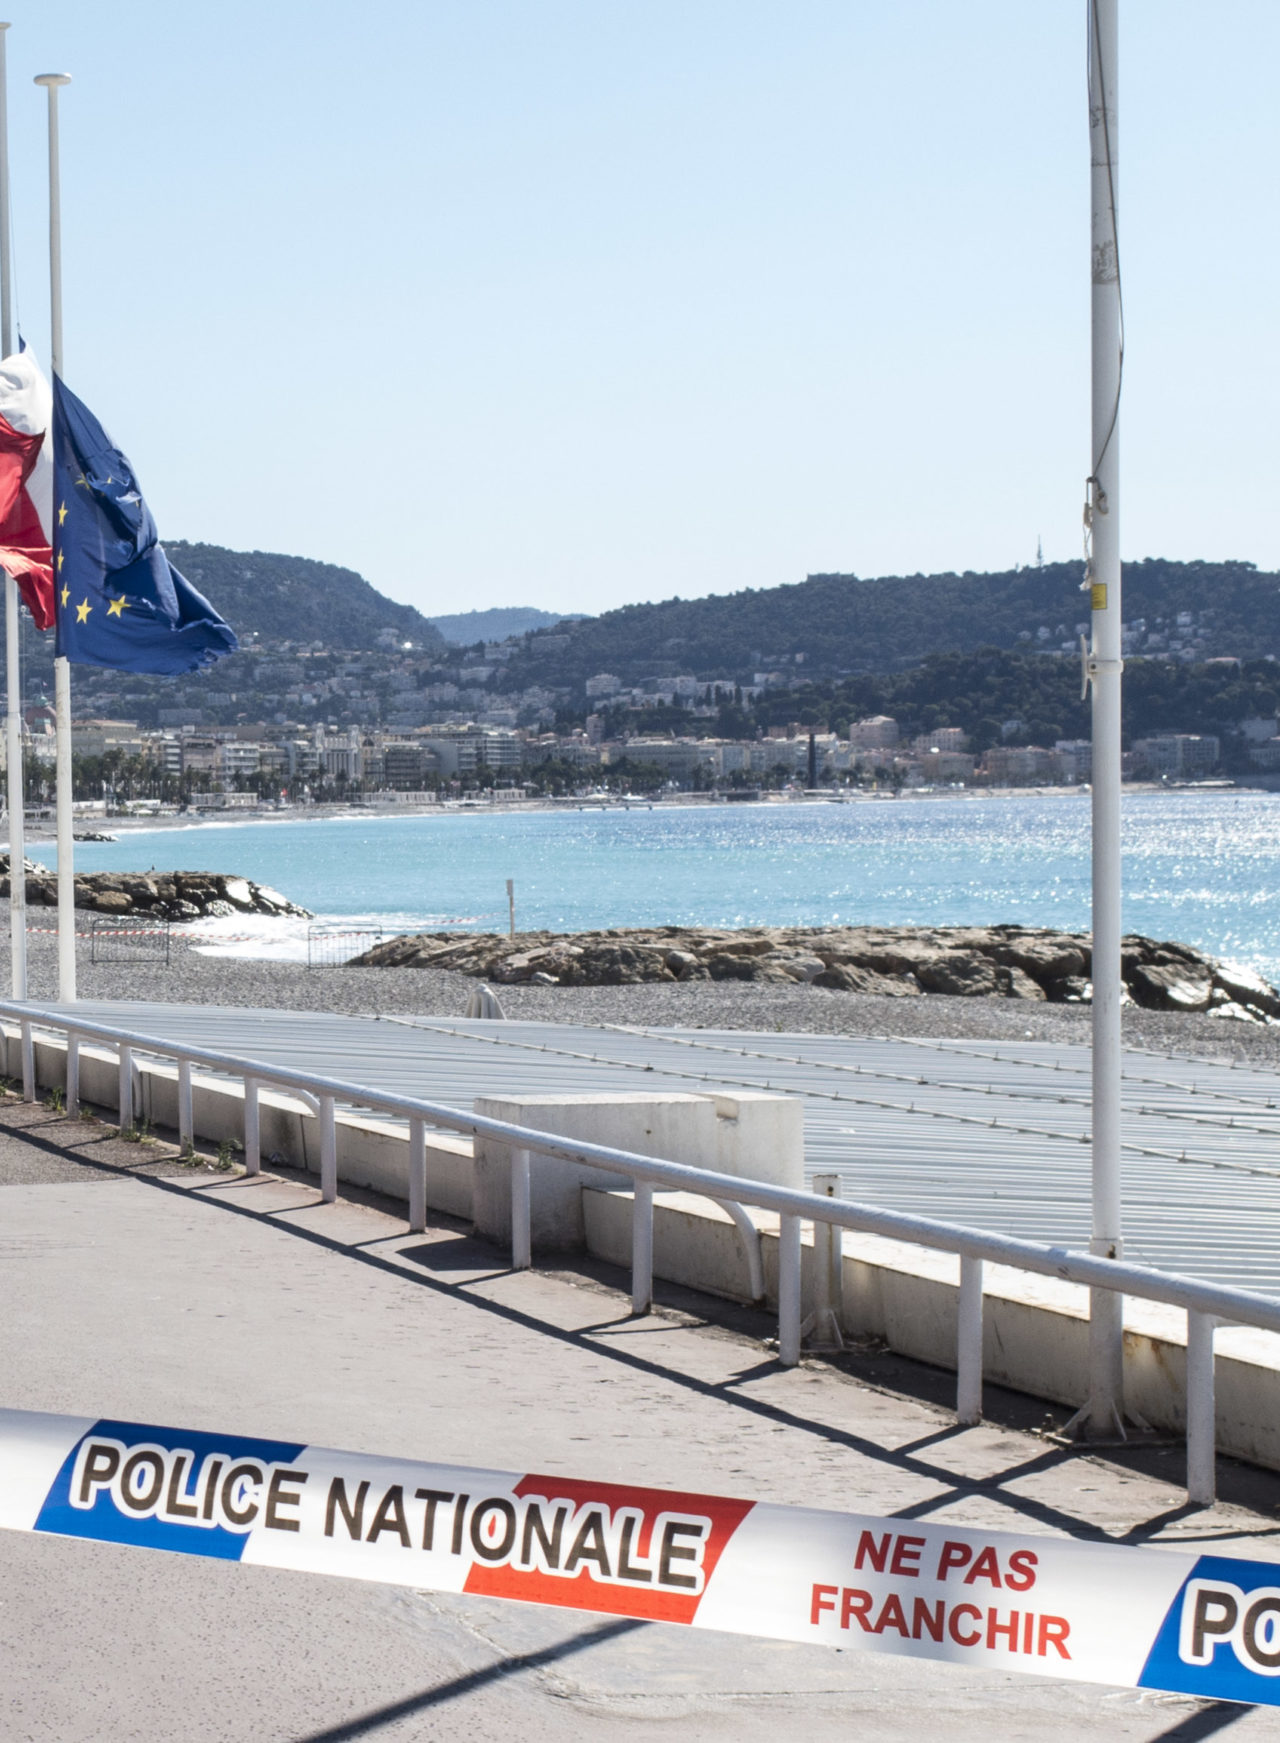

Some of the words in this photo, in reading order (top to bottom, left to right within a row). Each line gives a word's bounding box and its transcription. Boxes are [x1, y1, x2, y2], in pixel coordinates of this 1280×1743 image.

[78, 1444, 309, 1532] POLICE
[324, 1477, 704, 1589] NATIONALE
[854, 1530, 926, 1577] NE
[936, 1540, 1039, 1591] PAS
[810, 1583, 1072, 1660] FRANCHIR
